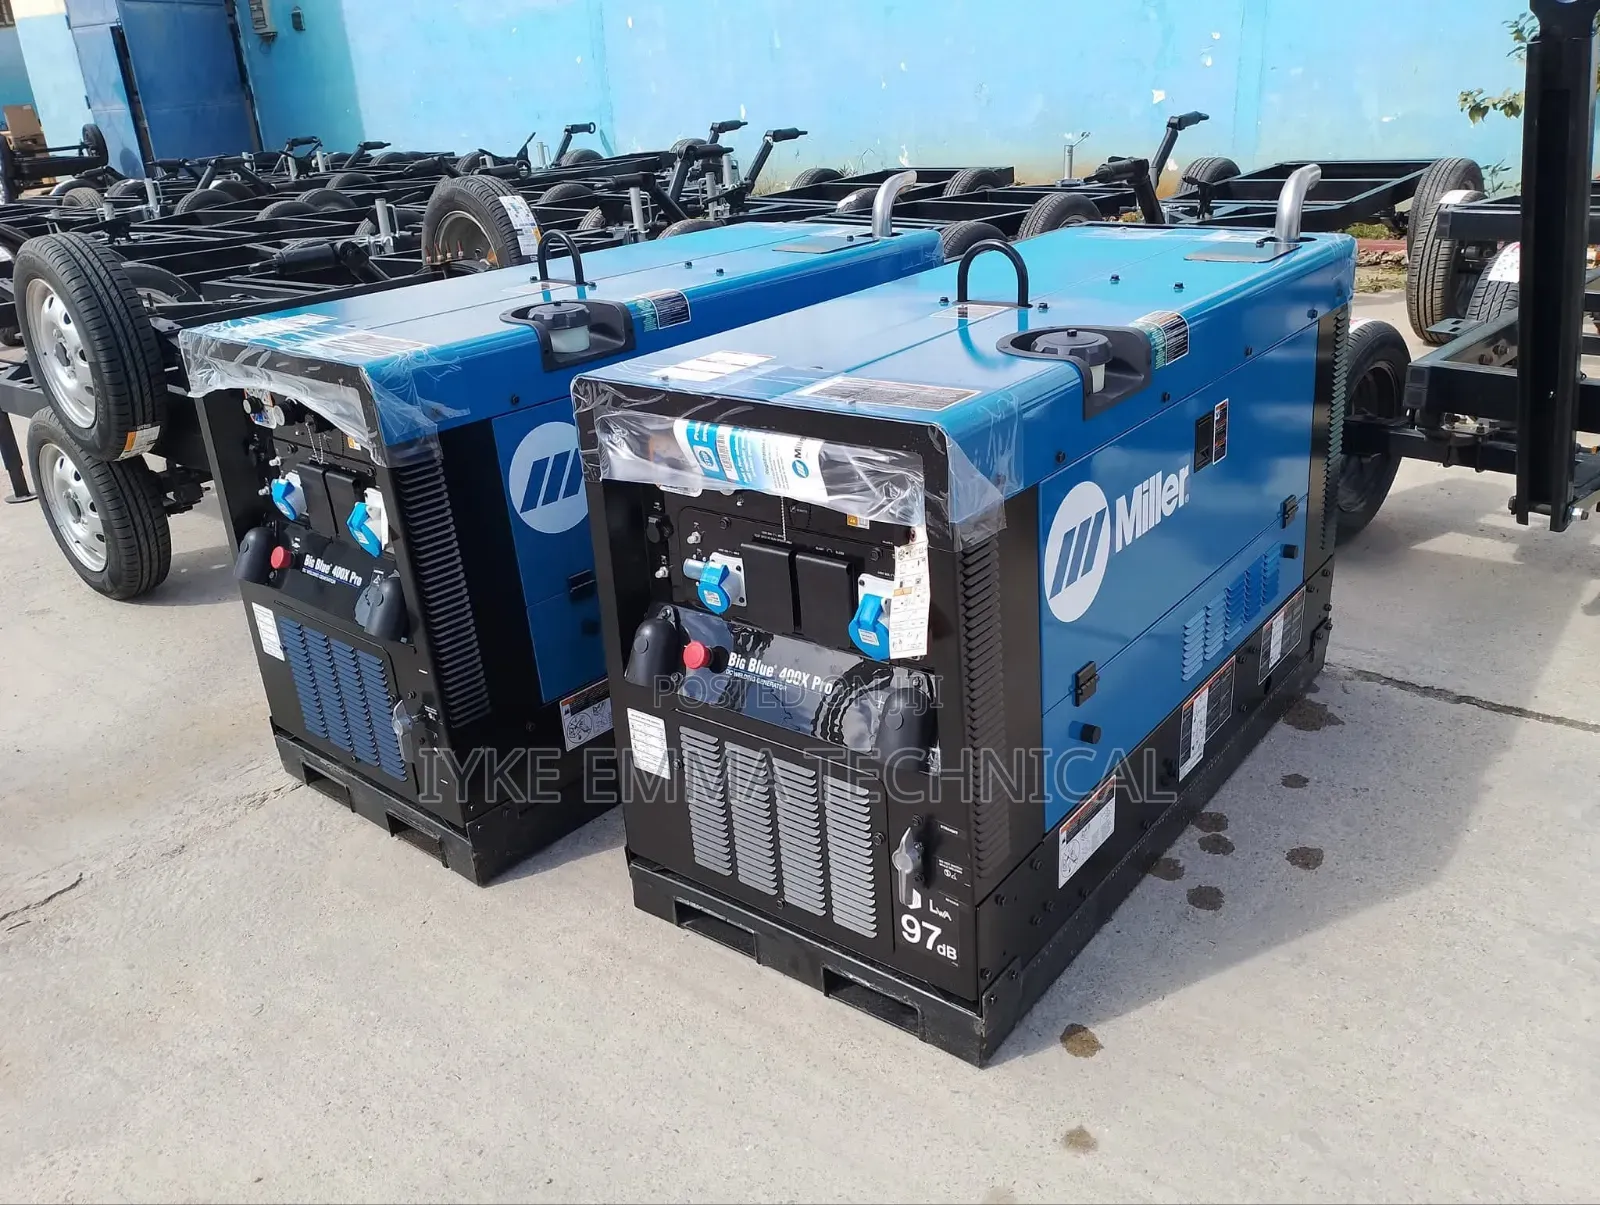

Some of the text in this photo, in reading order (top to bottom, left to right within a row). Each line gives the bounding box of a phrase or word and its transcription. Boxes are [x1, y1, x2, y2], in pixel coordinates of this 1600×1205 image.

[1115, 464, 1189, 553] Miller
[349, 571, 363, 587] Pro
[778, 667, 811, 689] 400X
[811, 675, 833, 695] Pro
